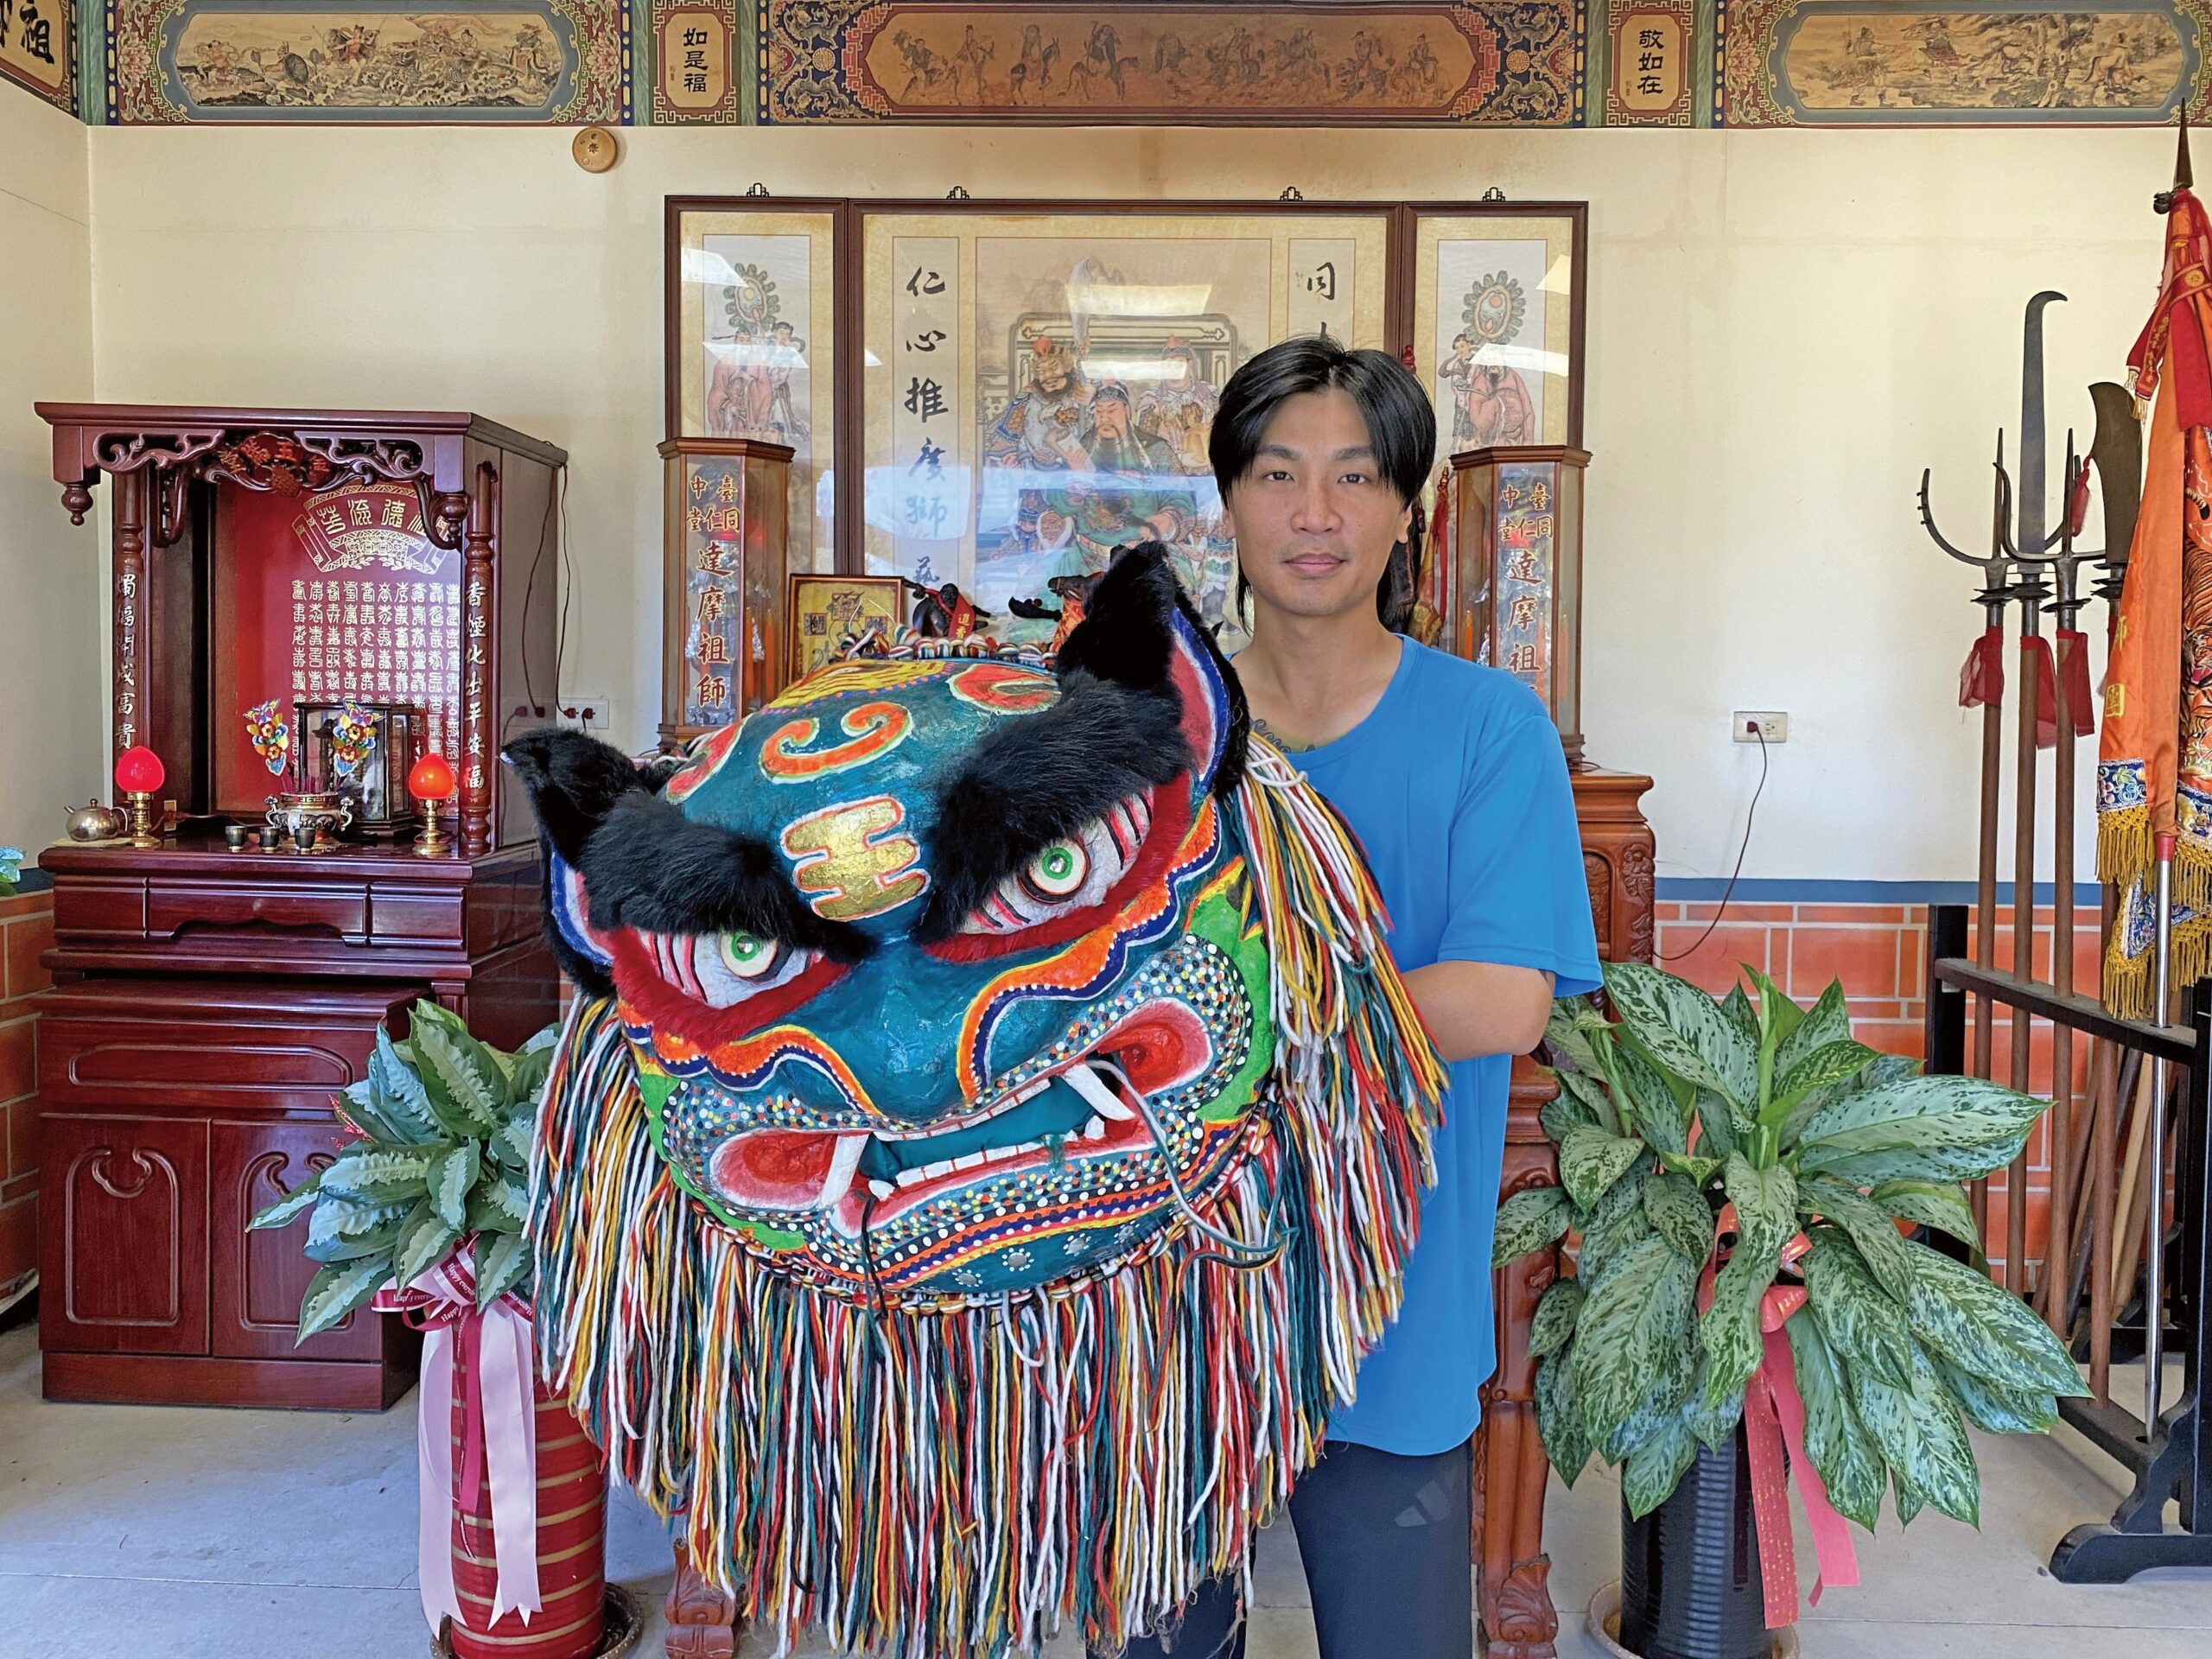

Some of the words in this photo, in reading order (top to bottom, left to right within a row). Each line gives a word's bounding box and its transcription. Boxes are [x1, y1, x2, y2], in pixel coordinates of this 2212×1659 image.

[683, 27, 709, 92] 如是福
[1637, 29, 1665, 95] 敬如在
[696, 541, 733, 709] 達摩祖師
[1506, 549, 1543, 691] 達摩祖
[465, 582, 486, 790] 香煙化出平安福
[441, 1305, 460, 1323] Happy
